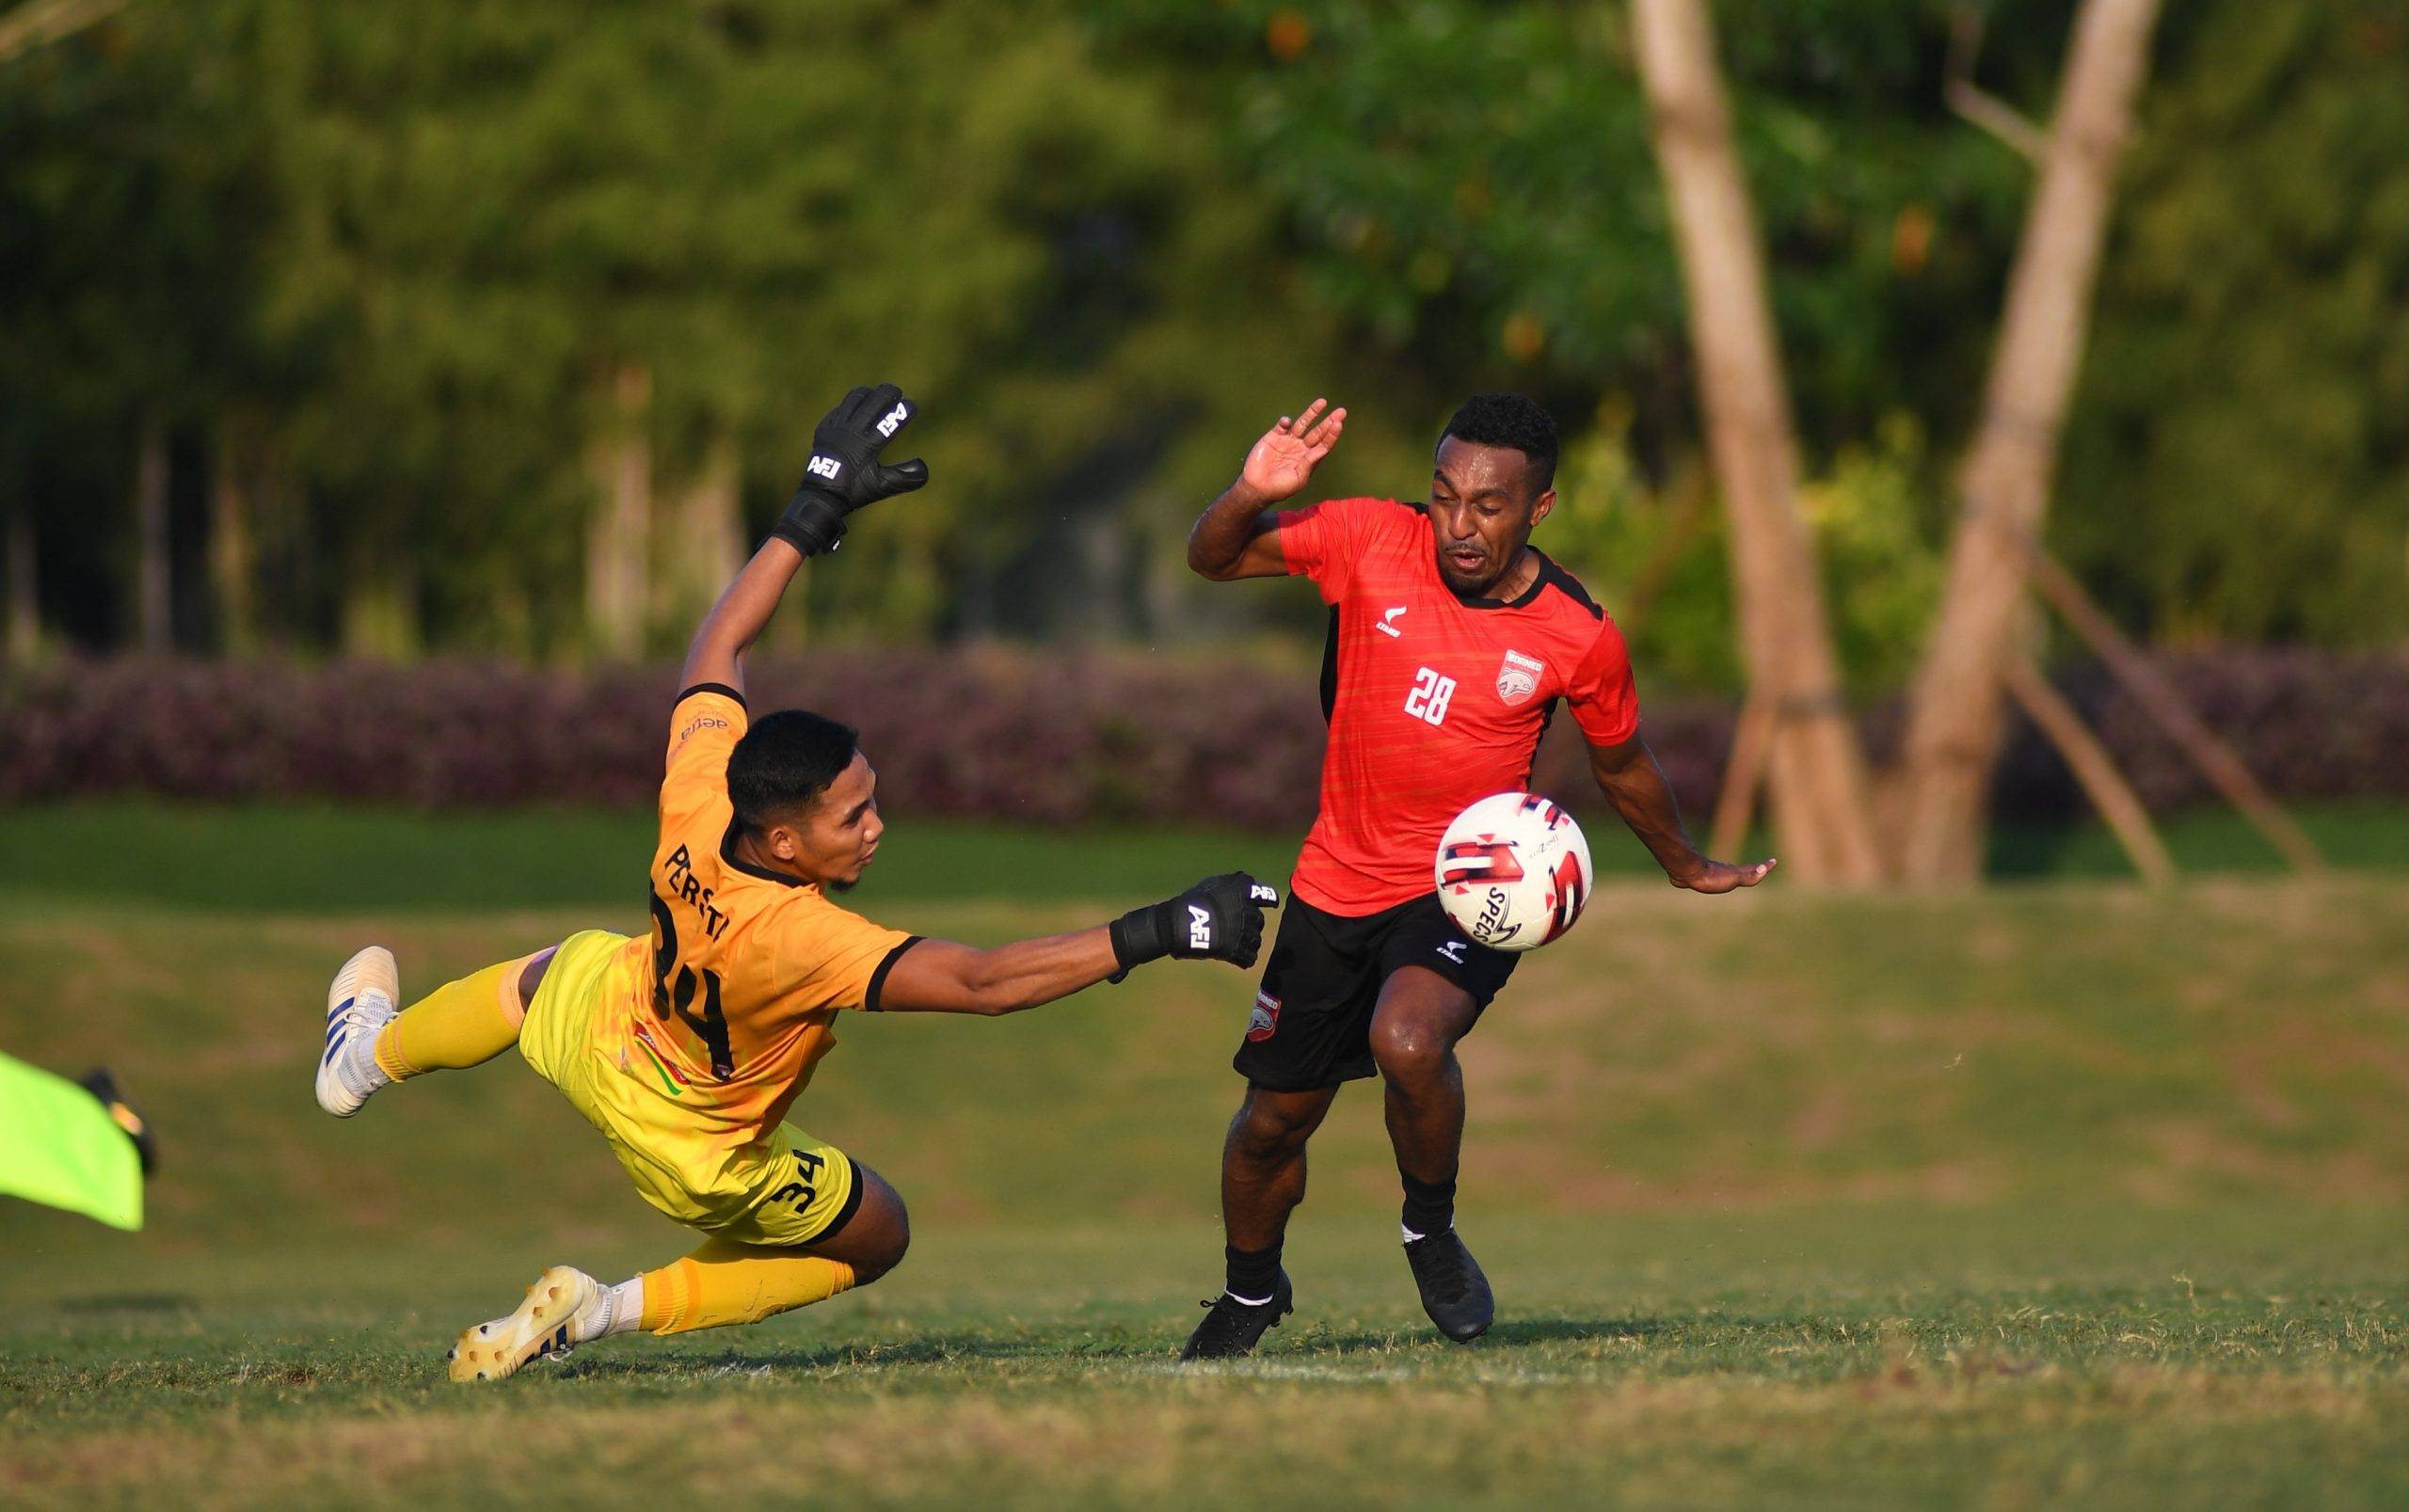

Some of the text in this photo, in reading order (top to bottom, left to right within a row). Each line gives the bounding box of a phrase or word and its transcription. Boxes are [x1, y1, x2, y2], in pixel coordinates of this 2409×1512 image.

[1403, 666, 1458, 726] 28
[1473, 887, 1506, 942] SPECS
[770, 1149, 825, 1215] 34
